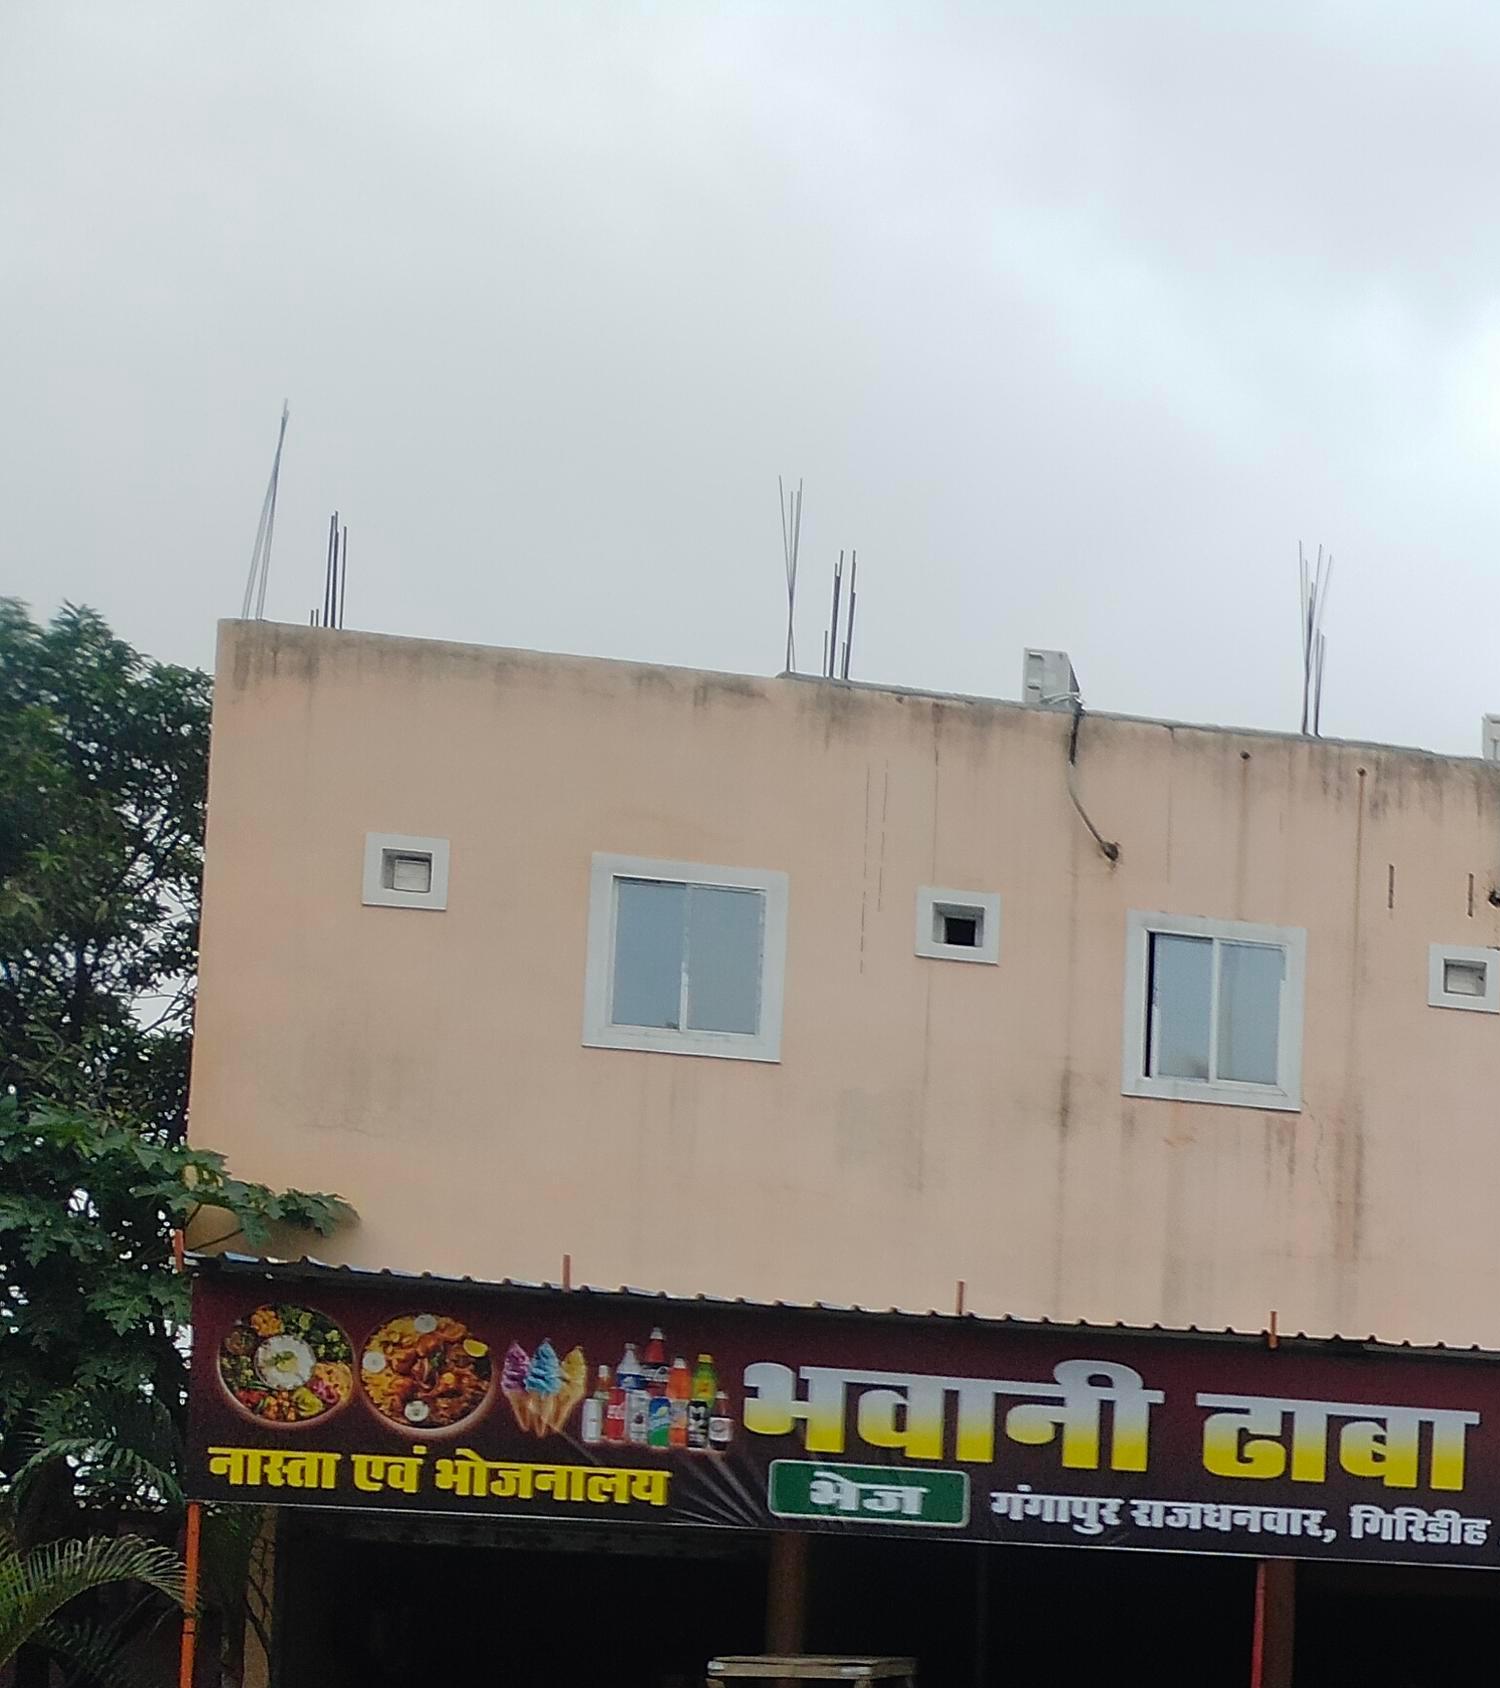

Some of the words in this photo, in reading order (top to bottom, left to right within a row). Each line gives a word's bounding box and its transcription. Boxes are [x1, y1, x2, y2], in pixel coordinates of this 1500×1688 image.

[743, 1359, 1165, 1472] भवानी
[1196, 1392, 1480, 1491] ढाबा
[208, 1446, 341, 1489] नास्ता
[352, 1445, 426, 1493] एवं
[435, 1448, 673, 1506] भोजनालय
[809, 1471, 931, 1515] भेज
[991, 1485, 1124, 1535] गंगापुर
[1130, 1499, 1338, 1543] राजधनवार,
[1350, 1504, 1491, 1546] गिरिडीह
